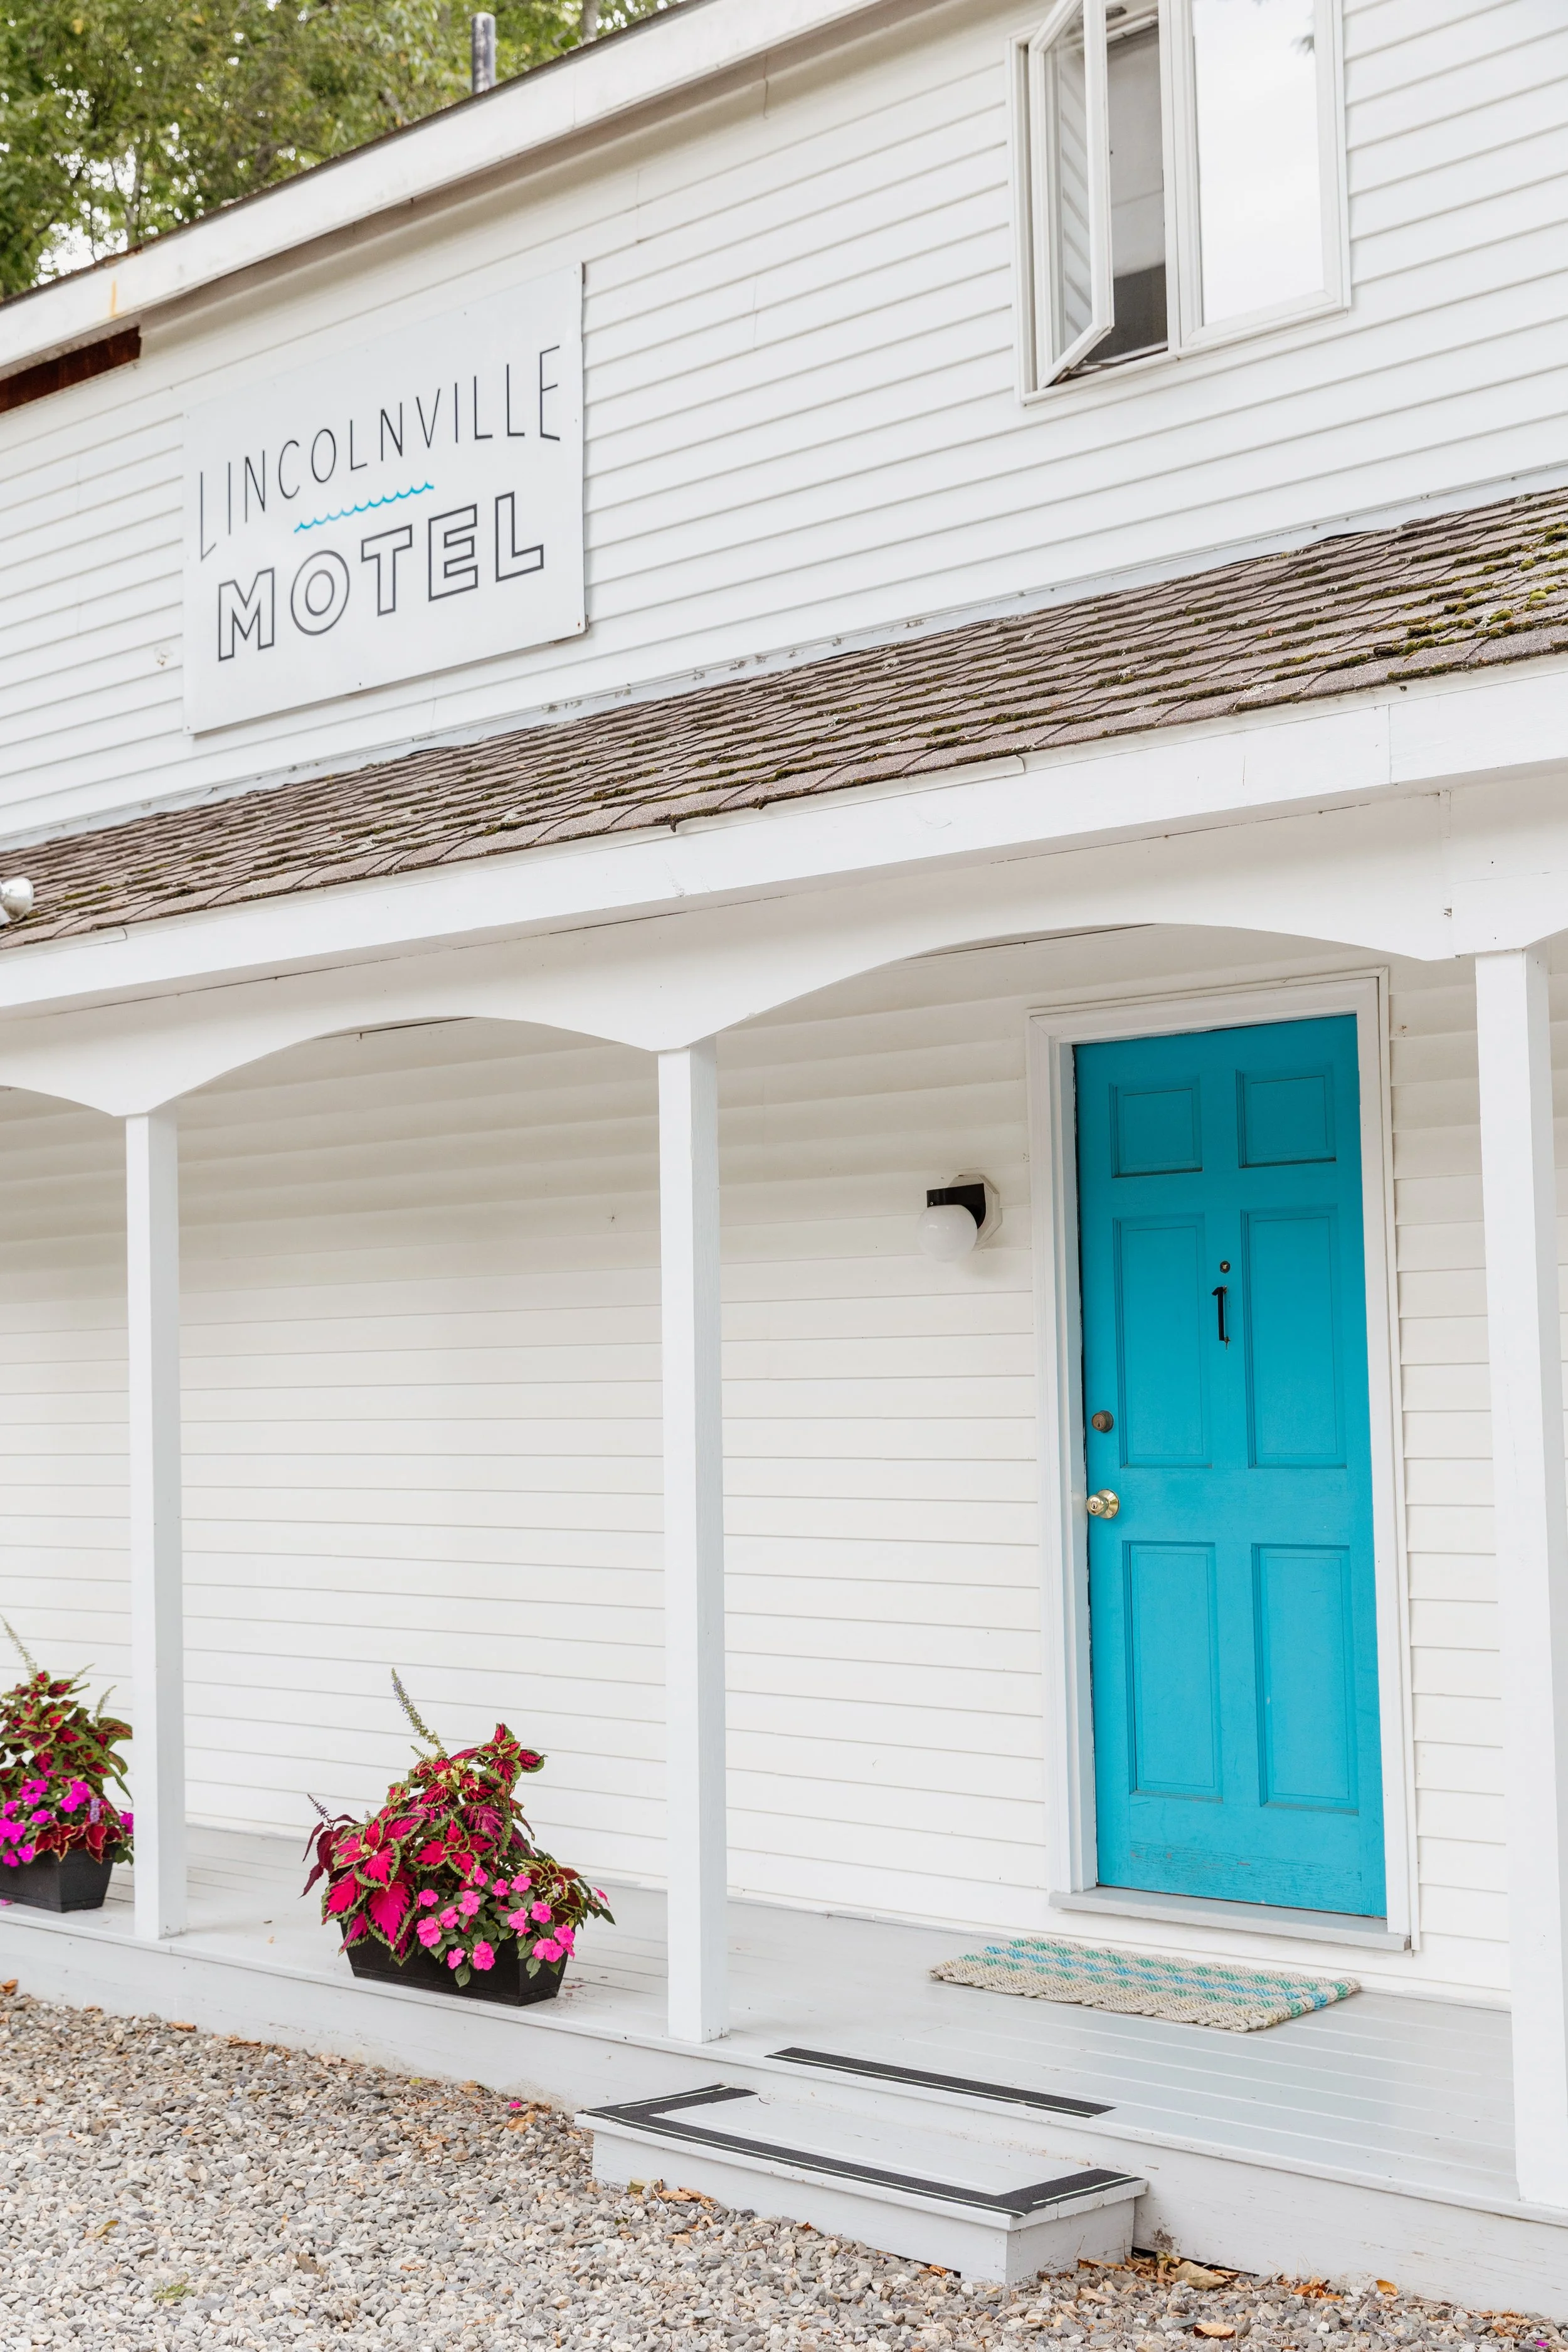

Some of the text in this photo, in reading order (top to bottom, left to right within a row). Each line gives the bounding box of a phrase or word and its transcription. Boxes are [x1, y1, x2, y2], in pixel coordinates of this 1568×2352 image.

[200, 345, 560, 561] LINCOLNVILLE
[218, 492, 544, 662] MOTEL
[1212, 1286, 1225, 1341] 1
